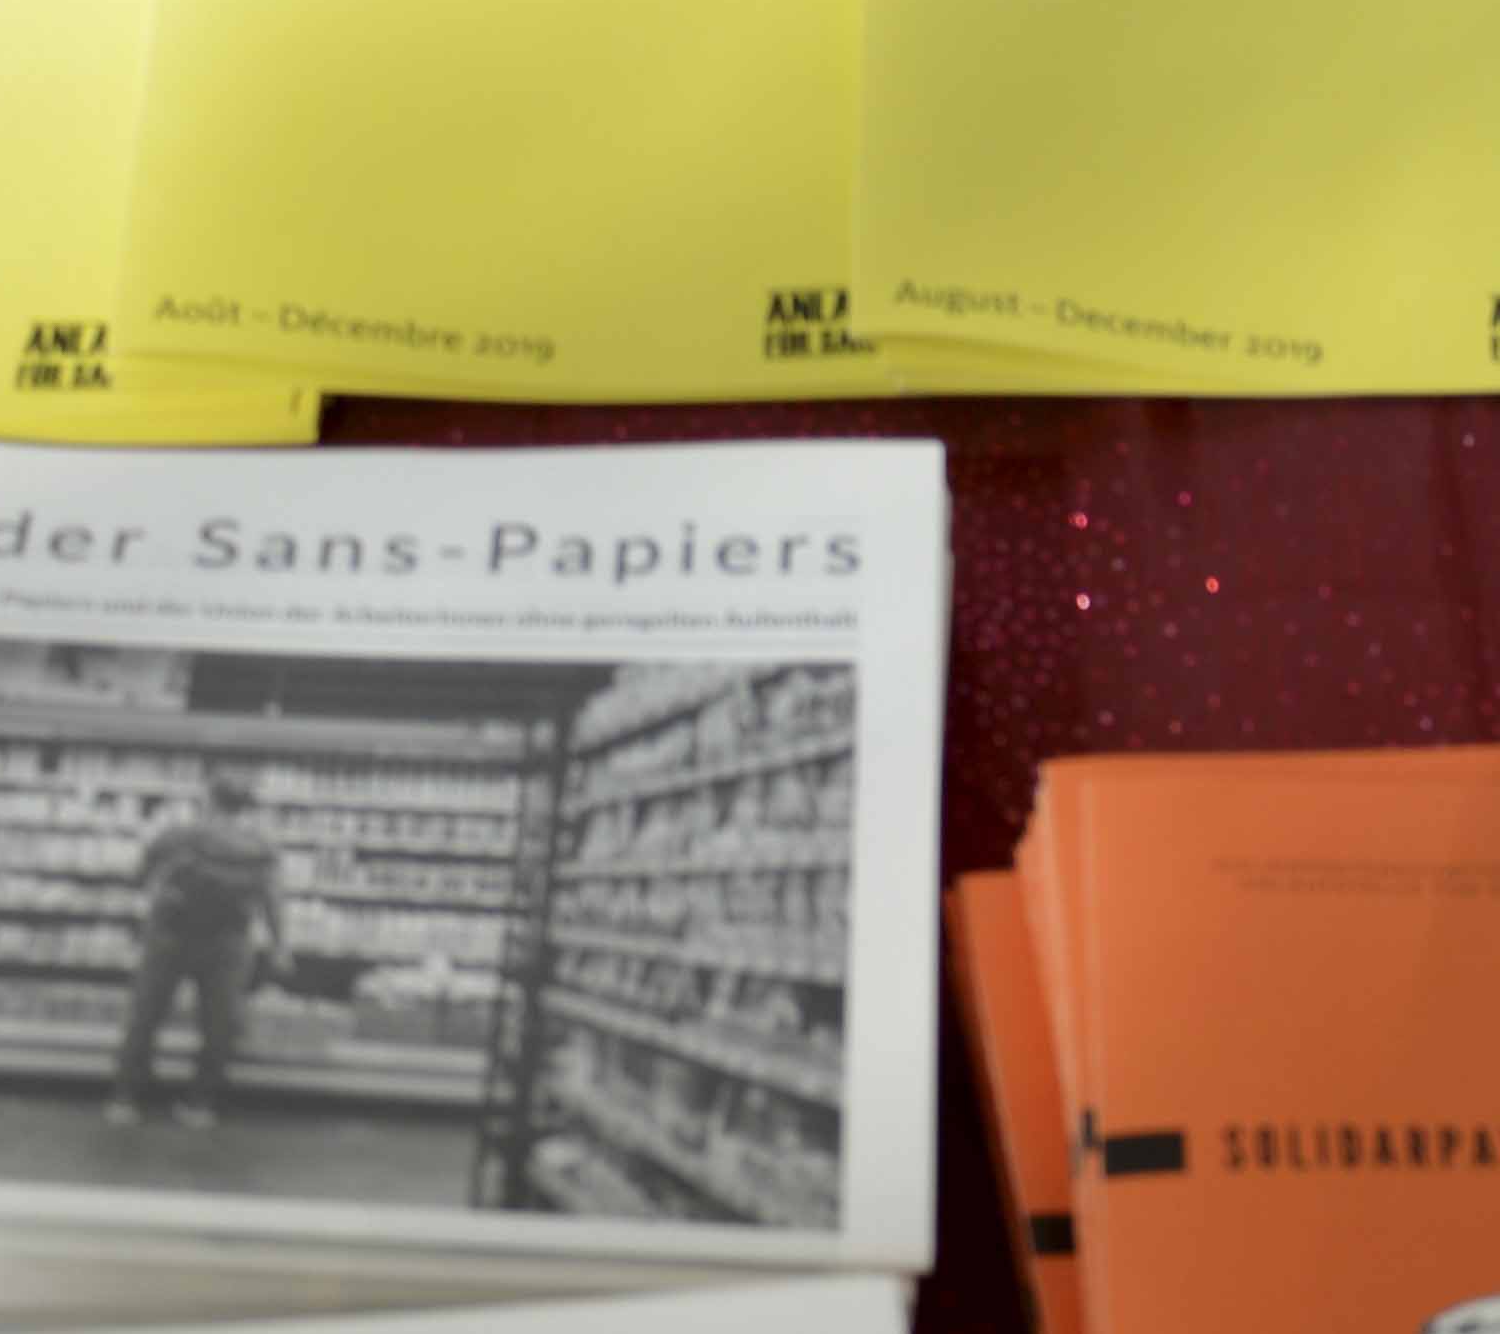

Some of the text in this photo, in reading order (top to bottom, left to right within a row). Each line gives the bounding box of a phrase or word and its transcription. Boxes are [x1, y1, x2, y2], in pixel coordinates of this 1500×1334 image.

[280, 302, 460, 358] Décembre
[470, 334, 556, 365] 2019
[893, 277, 1324, 367] August December 2019
[192, 517, 865, 587] Sans-Papiers
